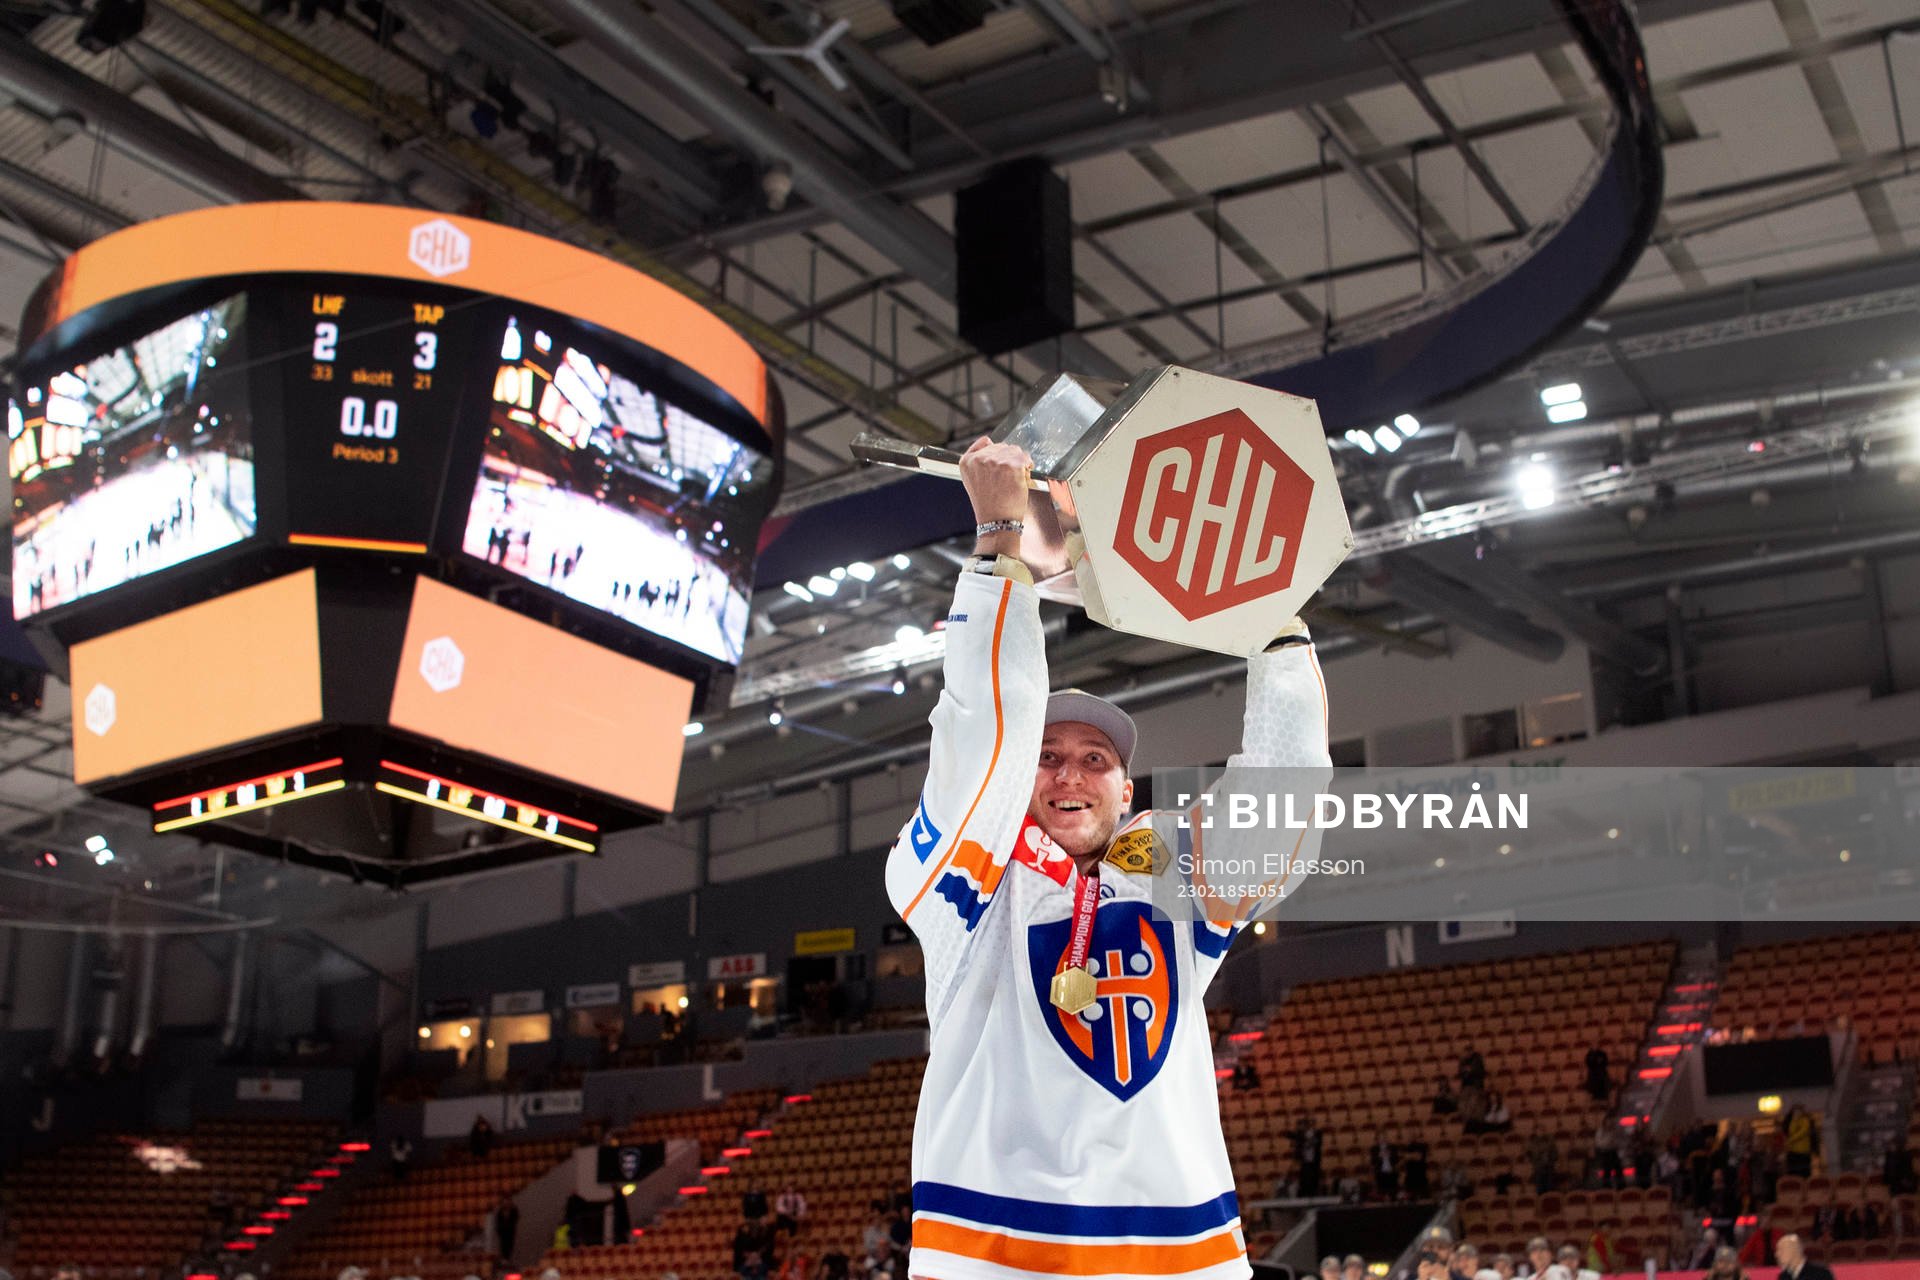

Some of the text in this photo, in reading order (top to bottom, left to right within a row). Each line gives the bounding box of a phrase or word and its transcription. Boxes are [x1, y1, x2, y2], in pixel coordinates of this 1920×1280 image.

[415, 228, 464, 268] CHL
[312, 294, 445, 325] LHF TAP
[313, 322, 437, 370] 2 3
[352, 368, 394, 388] skott
[340, 397, 398, 439] 0.0
[332, 443, 399, 464] Period 3
[1133, 432, 1287, 597] CHL
[1112, 843, 1136, 860] FINAL
[1081, 900, 1094, 913] GO
[1386, 926, 1415, 966] N
[720, 956, 755, 977] ABB
[703, 1065, 722, 1100] L
[505, 1094, 528, 1130] K
